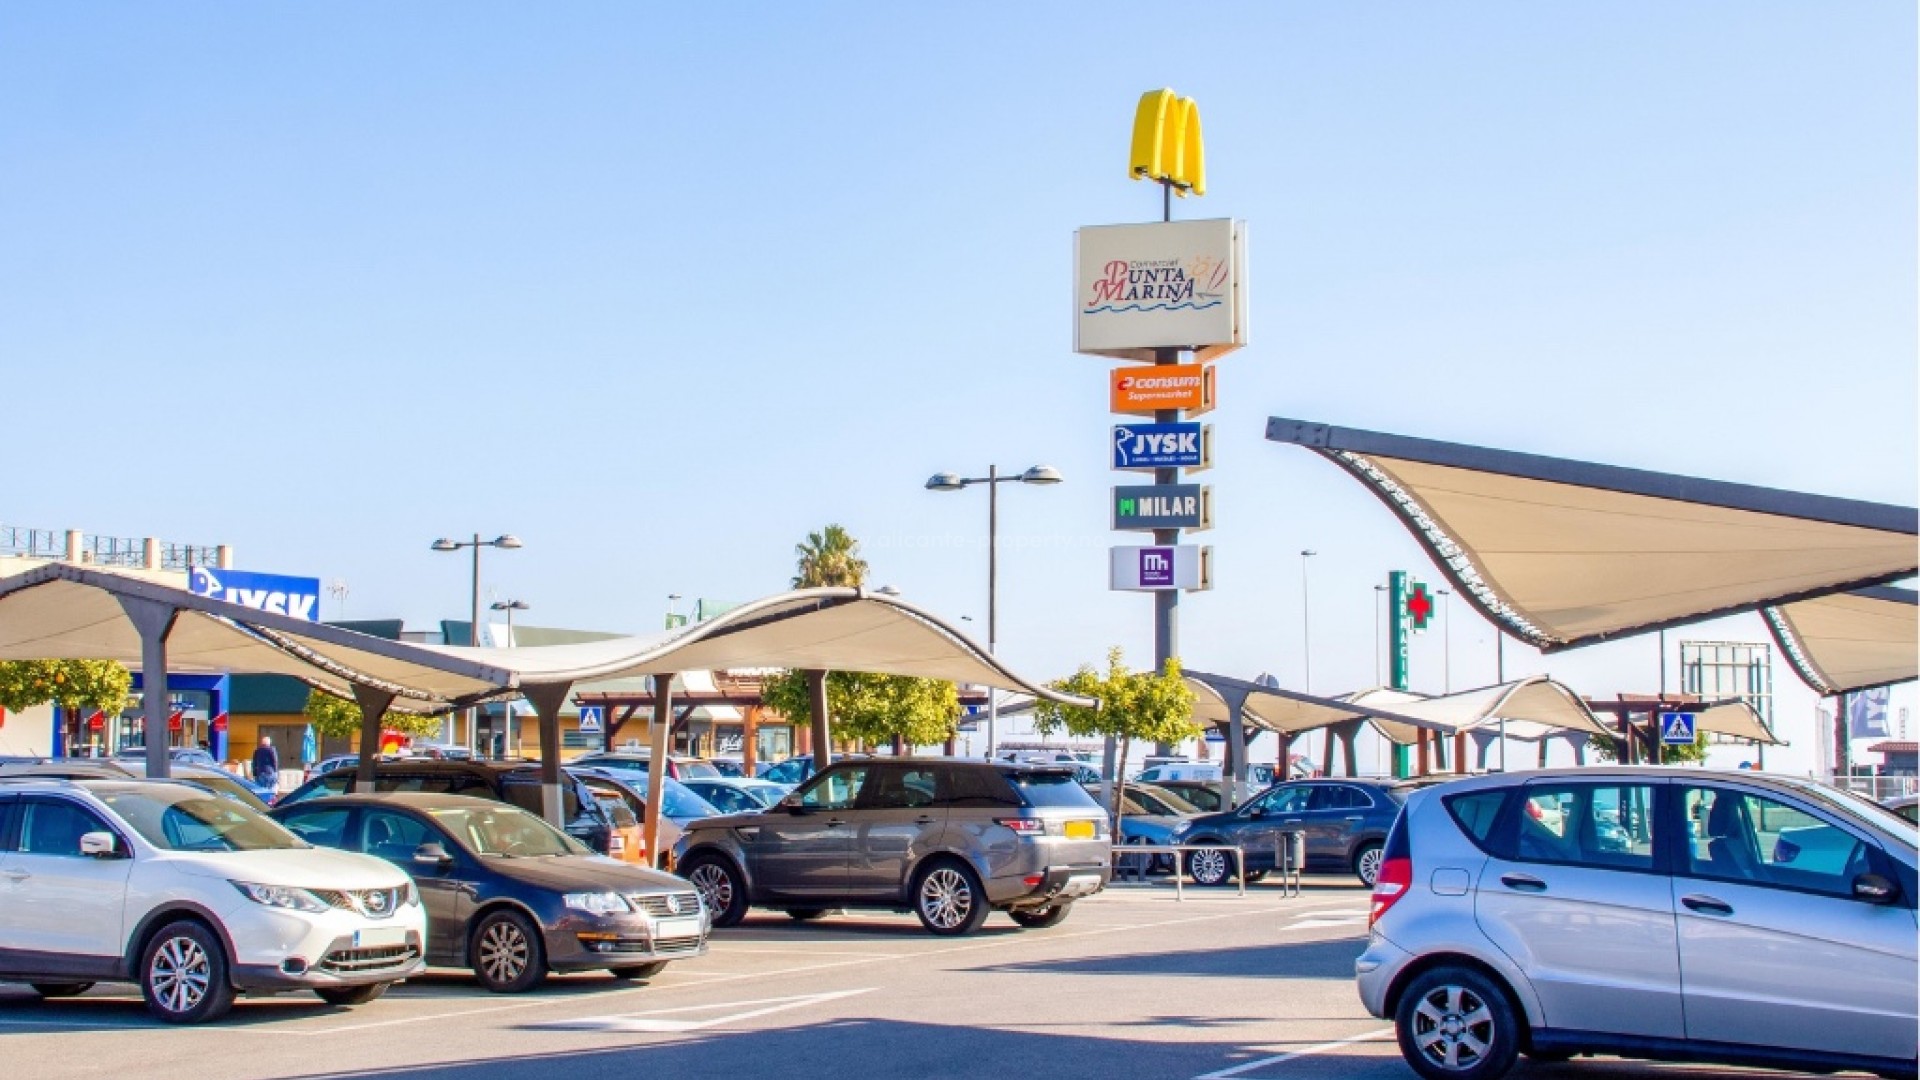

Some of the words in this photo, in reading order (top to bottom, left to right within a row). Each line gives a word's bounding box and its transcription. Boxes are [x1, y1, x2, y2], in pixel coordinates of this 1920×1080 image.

[1104, 260, 1185, 285] PUNTA
[1088, 278, 1195, 306] MARINA
[1135, 376, 1200, 388] consum
[1128, 390, 1193, 402] Supermarket
[1132, 433, 1198, 454] JYSK
[1139, 496, 1196, 517] MILAR
